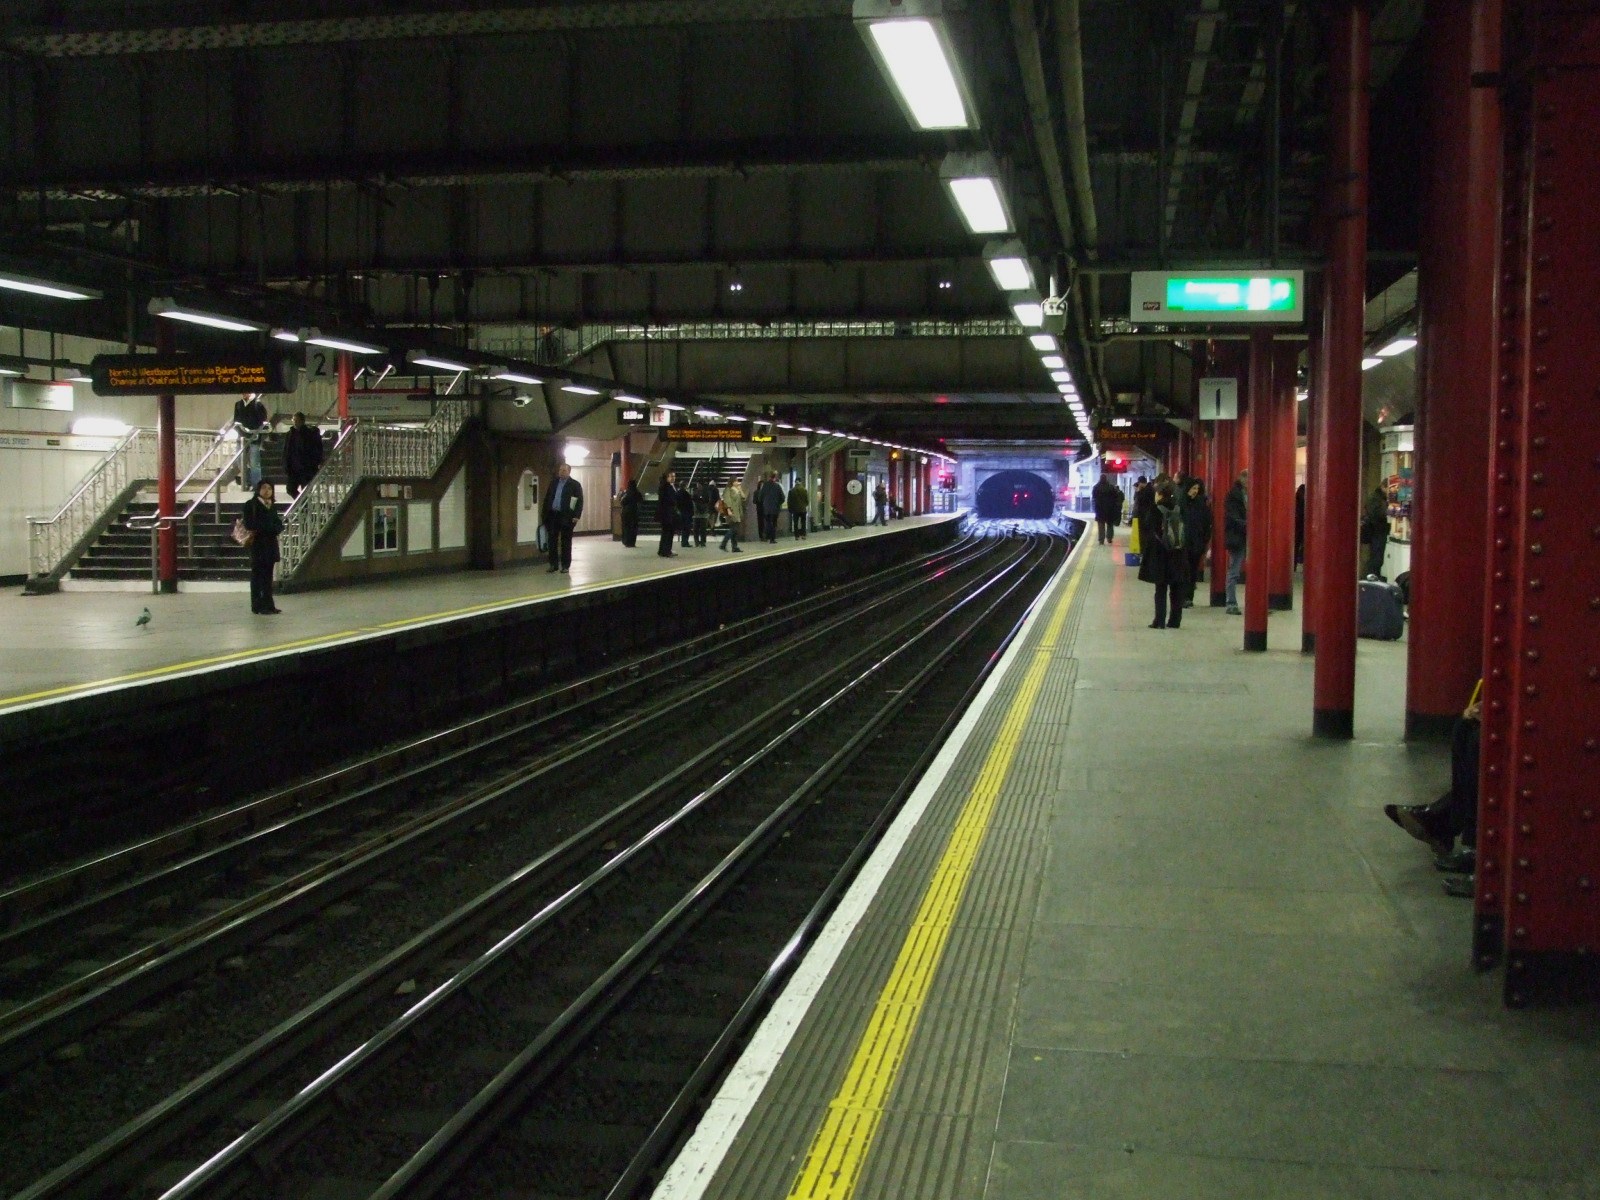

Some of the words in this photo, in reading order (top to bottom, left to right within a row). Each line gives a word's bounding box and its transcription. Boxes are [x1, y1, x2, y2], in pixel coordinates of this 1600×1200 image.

[109, 368, 130, 377] North
[139, 367, 178, 377] Westbound
[179, 367, 202, 376] Trains
[203, 367, 214, 375] via
[215, 365, 237, 375] Baker
[239, 365, 265, 375] Street
[313, 352, 326, 376] 2
[110, 377, 137, 386] Change
[147, 376, 180, 386] Chalfont
[188, 375, 215, 385] Latimer
[217, 375, 231, 384] for
[232, 374, 266, 384] Chesham
[1215, 388, 1221, 416] 1
